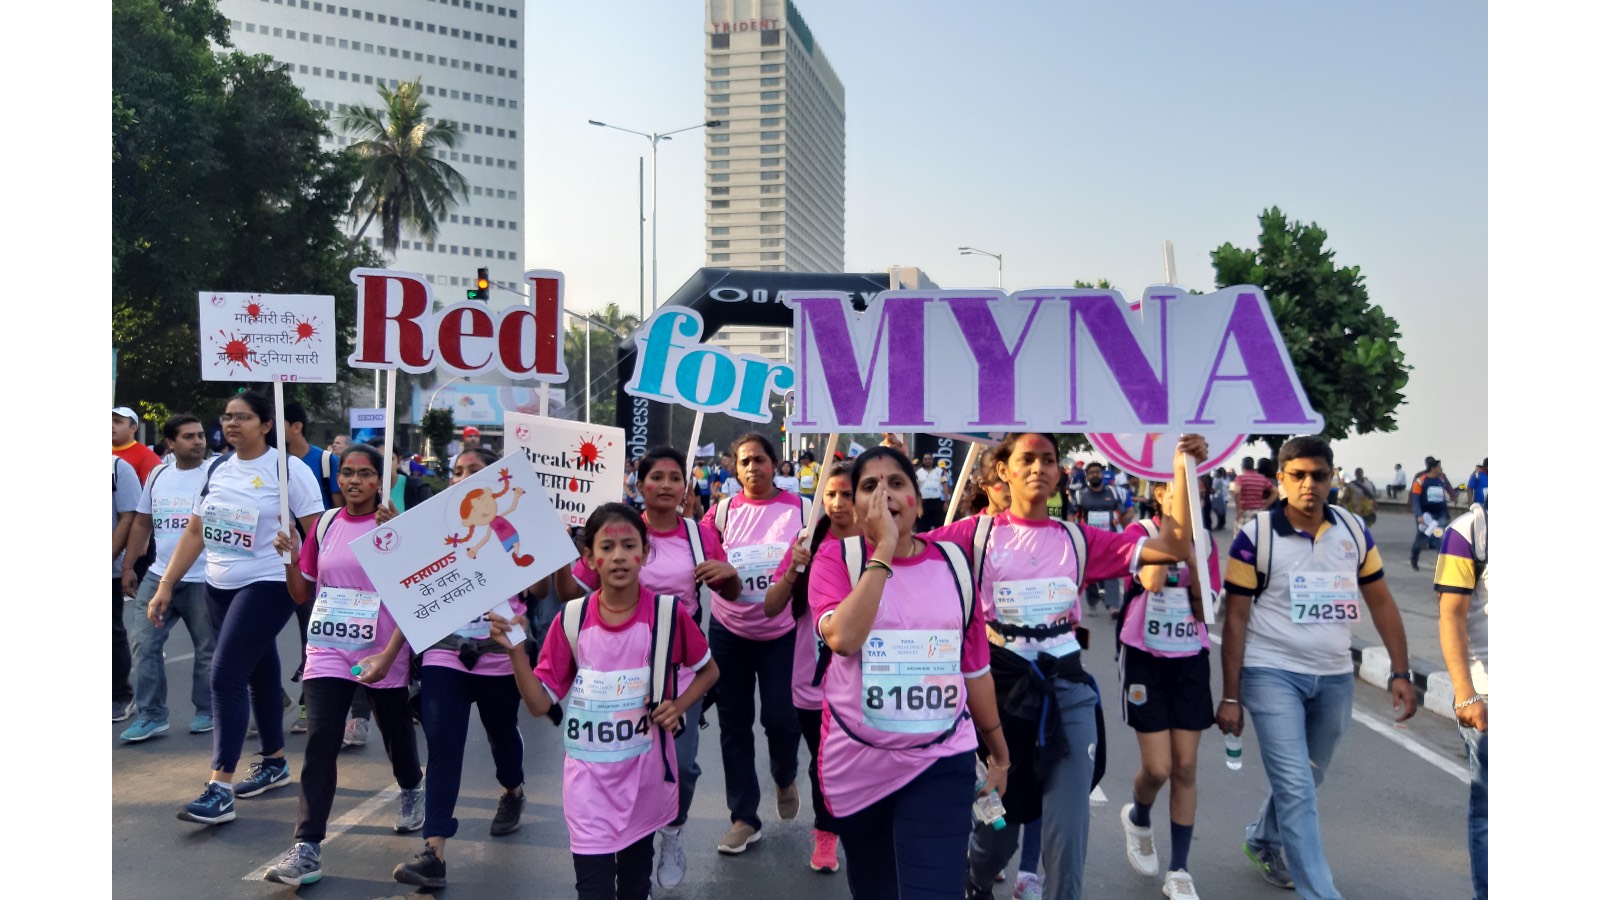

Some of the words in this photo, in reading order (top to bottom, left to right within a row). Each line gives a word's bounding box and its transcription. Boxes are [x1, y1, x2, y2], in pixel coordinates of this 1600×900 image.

[713, 18, 778, 33] TRIDENT
[280, 311, 296, 325] की
[355, 274, 563, 375] Red
[260, 350, 292, 366] दुनिया
[295, 351, 319, 364] सारी
[631, 311, 795, 417] for
[790, 293, 1317, 426] MYNA
[576, 455, 606, 474] the
[535, 471, 594, 494] ERIOD
[549, 493, 585, 513] boo
[204, 526, 252, 548] 63275
[400, 551, 457, 589] PERIODS
[419, 583, 435, 597] के
[435, 568, 461, 588] वक्त
[413, 599, 441, 619] खेल
[440, 577, 475, 604] सकते
[1294, 604, 1358, 620] 74253
[310, 620, 374, 640] 80933
[866, 685, 958, 710] 81602
[567, 715, 650, 743] 81604
